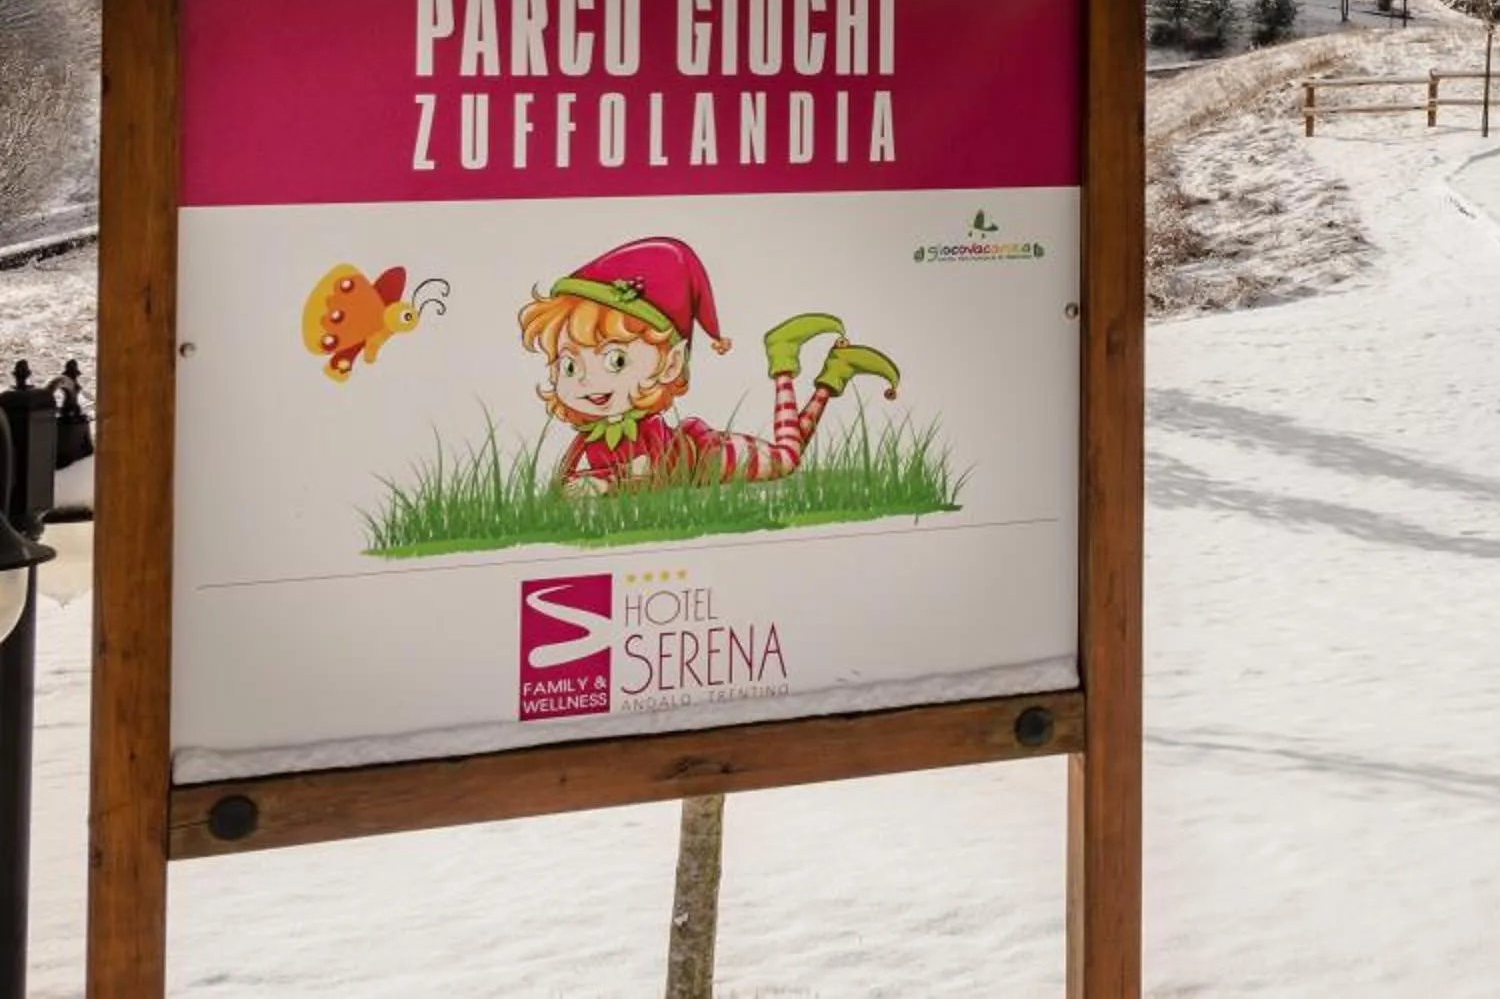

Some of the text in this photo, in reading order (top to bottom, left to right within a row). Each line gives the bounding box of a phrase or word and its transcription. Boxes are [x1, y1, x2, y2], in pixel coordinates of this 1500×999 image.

[413, 91, 896, 169] ZUFFOLANDIA
[625, 588, 717, 627] HOTEL
[621, 622, 787, 695] SERENA
[523, 675, 607, 696] FAMILY &
[523, 693, 607, 714] WELLNESS
